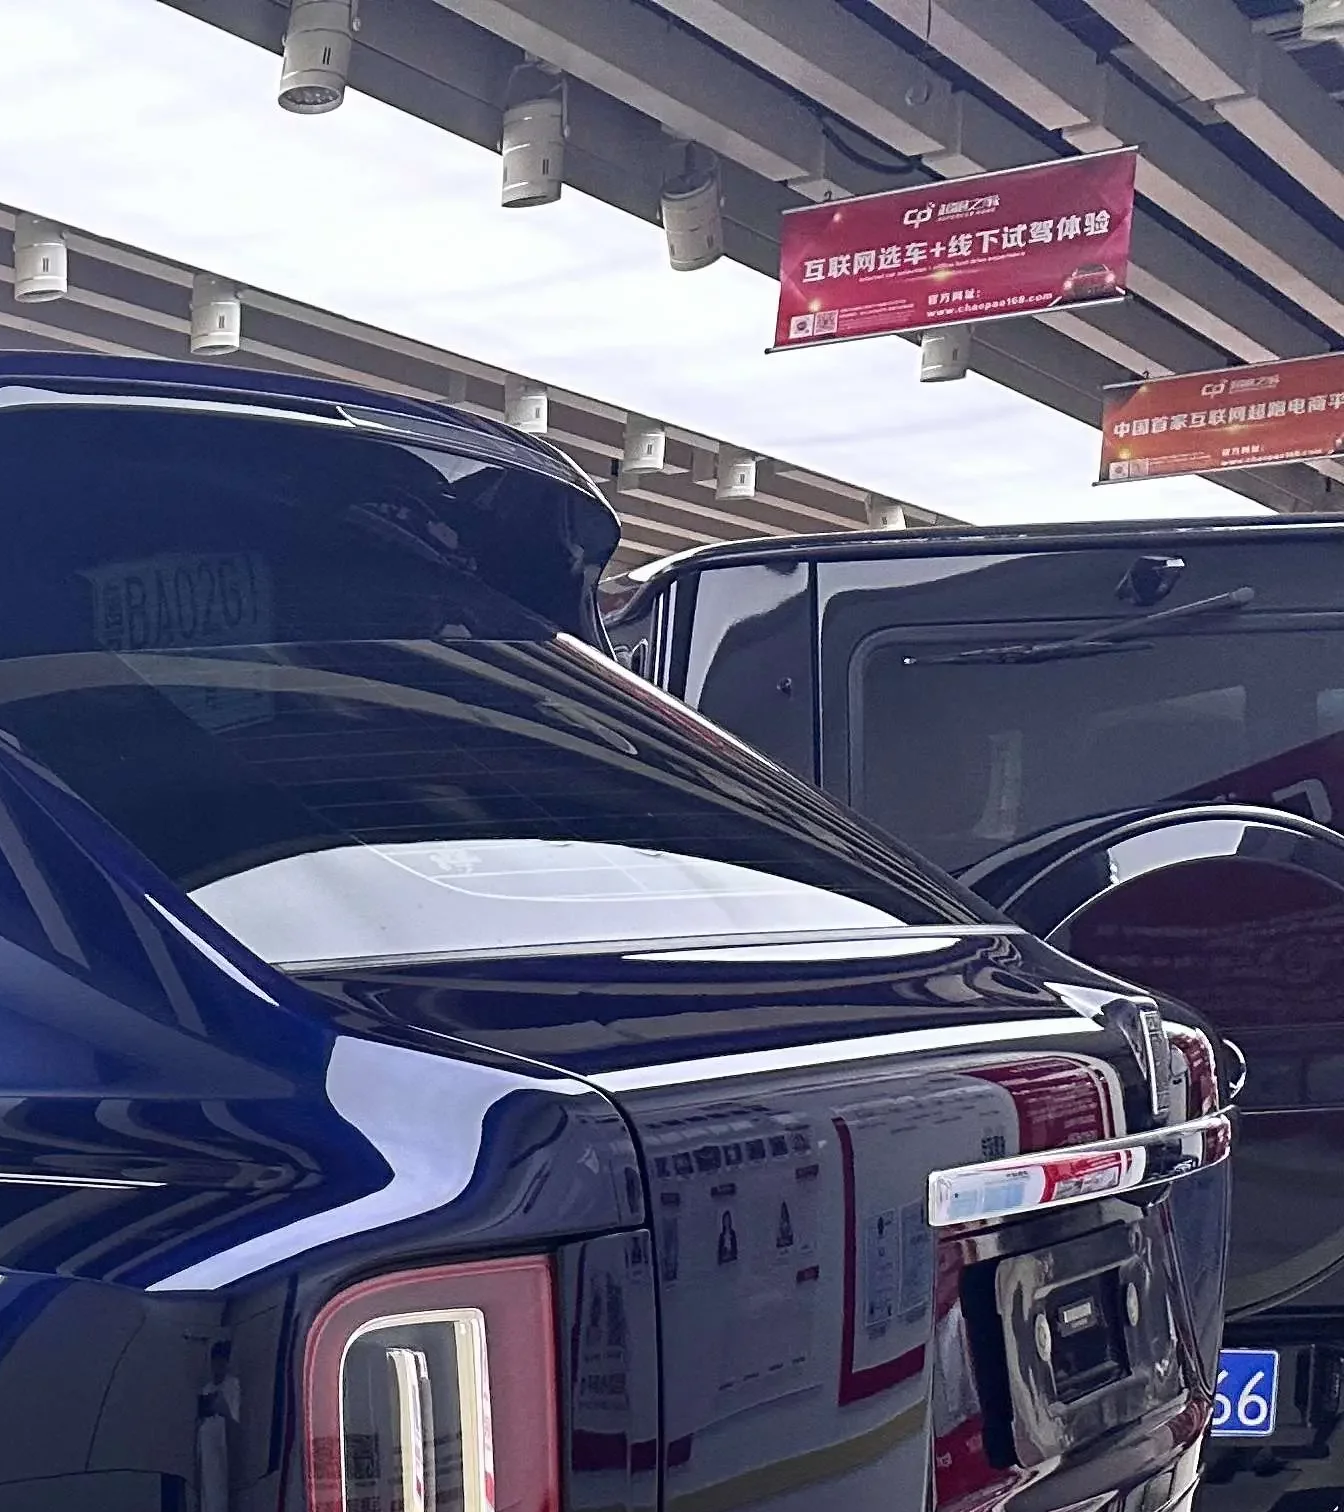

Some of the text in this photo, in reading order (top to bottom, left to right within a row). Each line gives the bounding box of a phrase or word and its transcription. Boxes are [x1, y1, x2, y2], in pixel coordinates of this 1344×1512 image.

[802, 210, 1111, 284] 互联网选车+线下试驾体验
